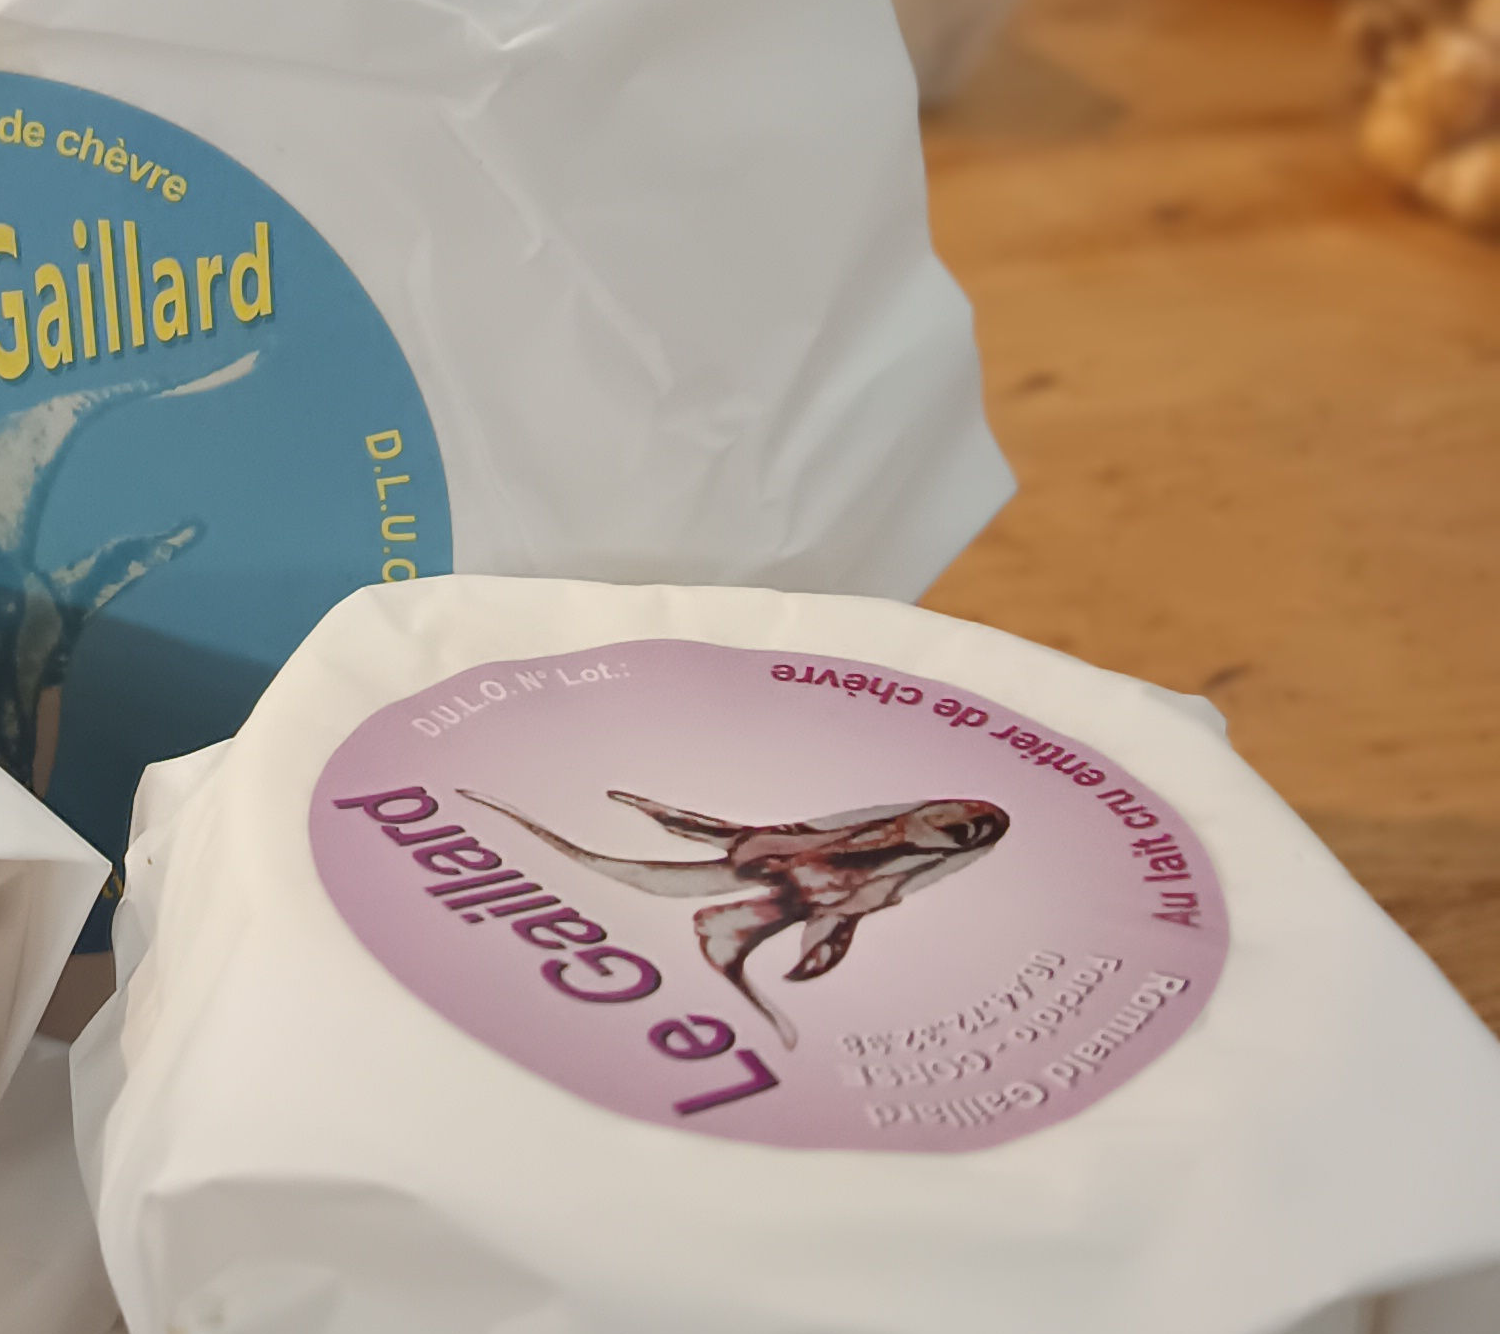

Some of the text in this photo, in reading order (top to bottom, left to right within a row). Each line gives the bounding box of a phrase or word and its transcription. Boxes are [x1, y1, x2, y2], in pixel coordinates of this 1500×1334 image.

[56, 127, 187, 202] chèvre
[770, 664, 1202, 929] Au lait cru entier de chèvre
[333, 785, 780, 1117] Le Gaillard
[866, 971, 1192, 1128] Romuald Gaillard
